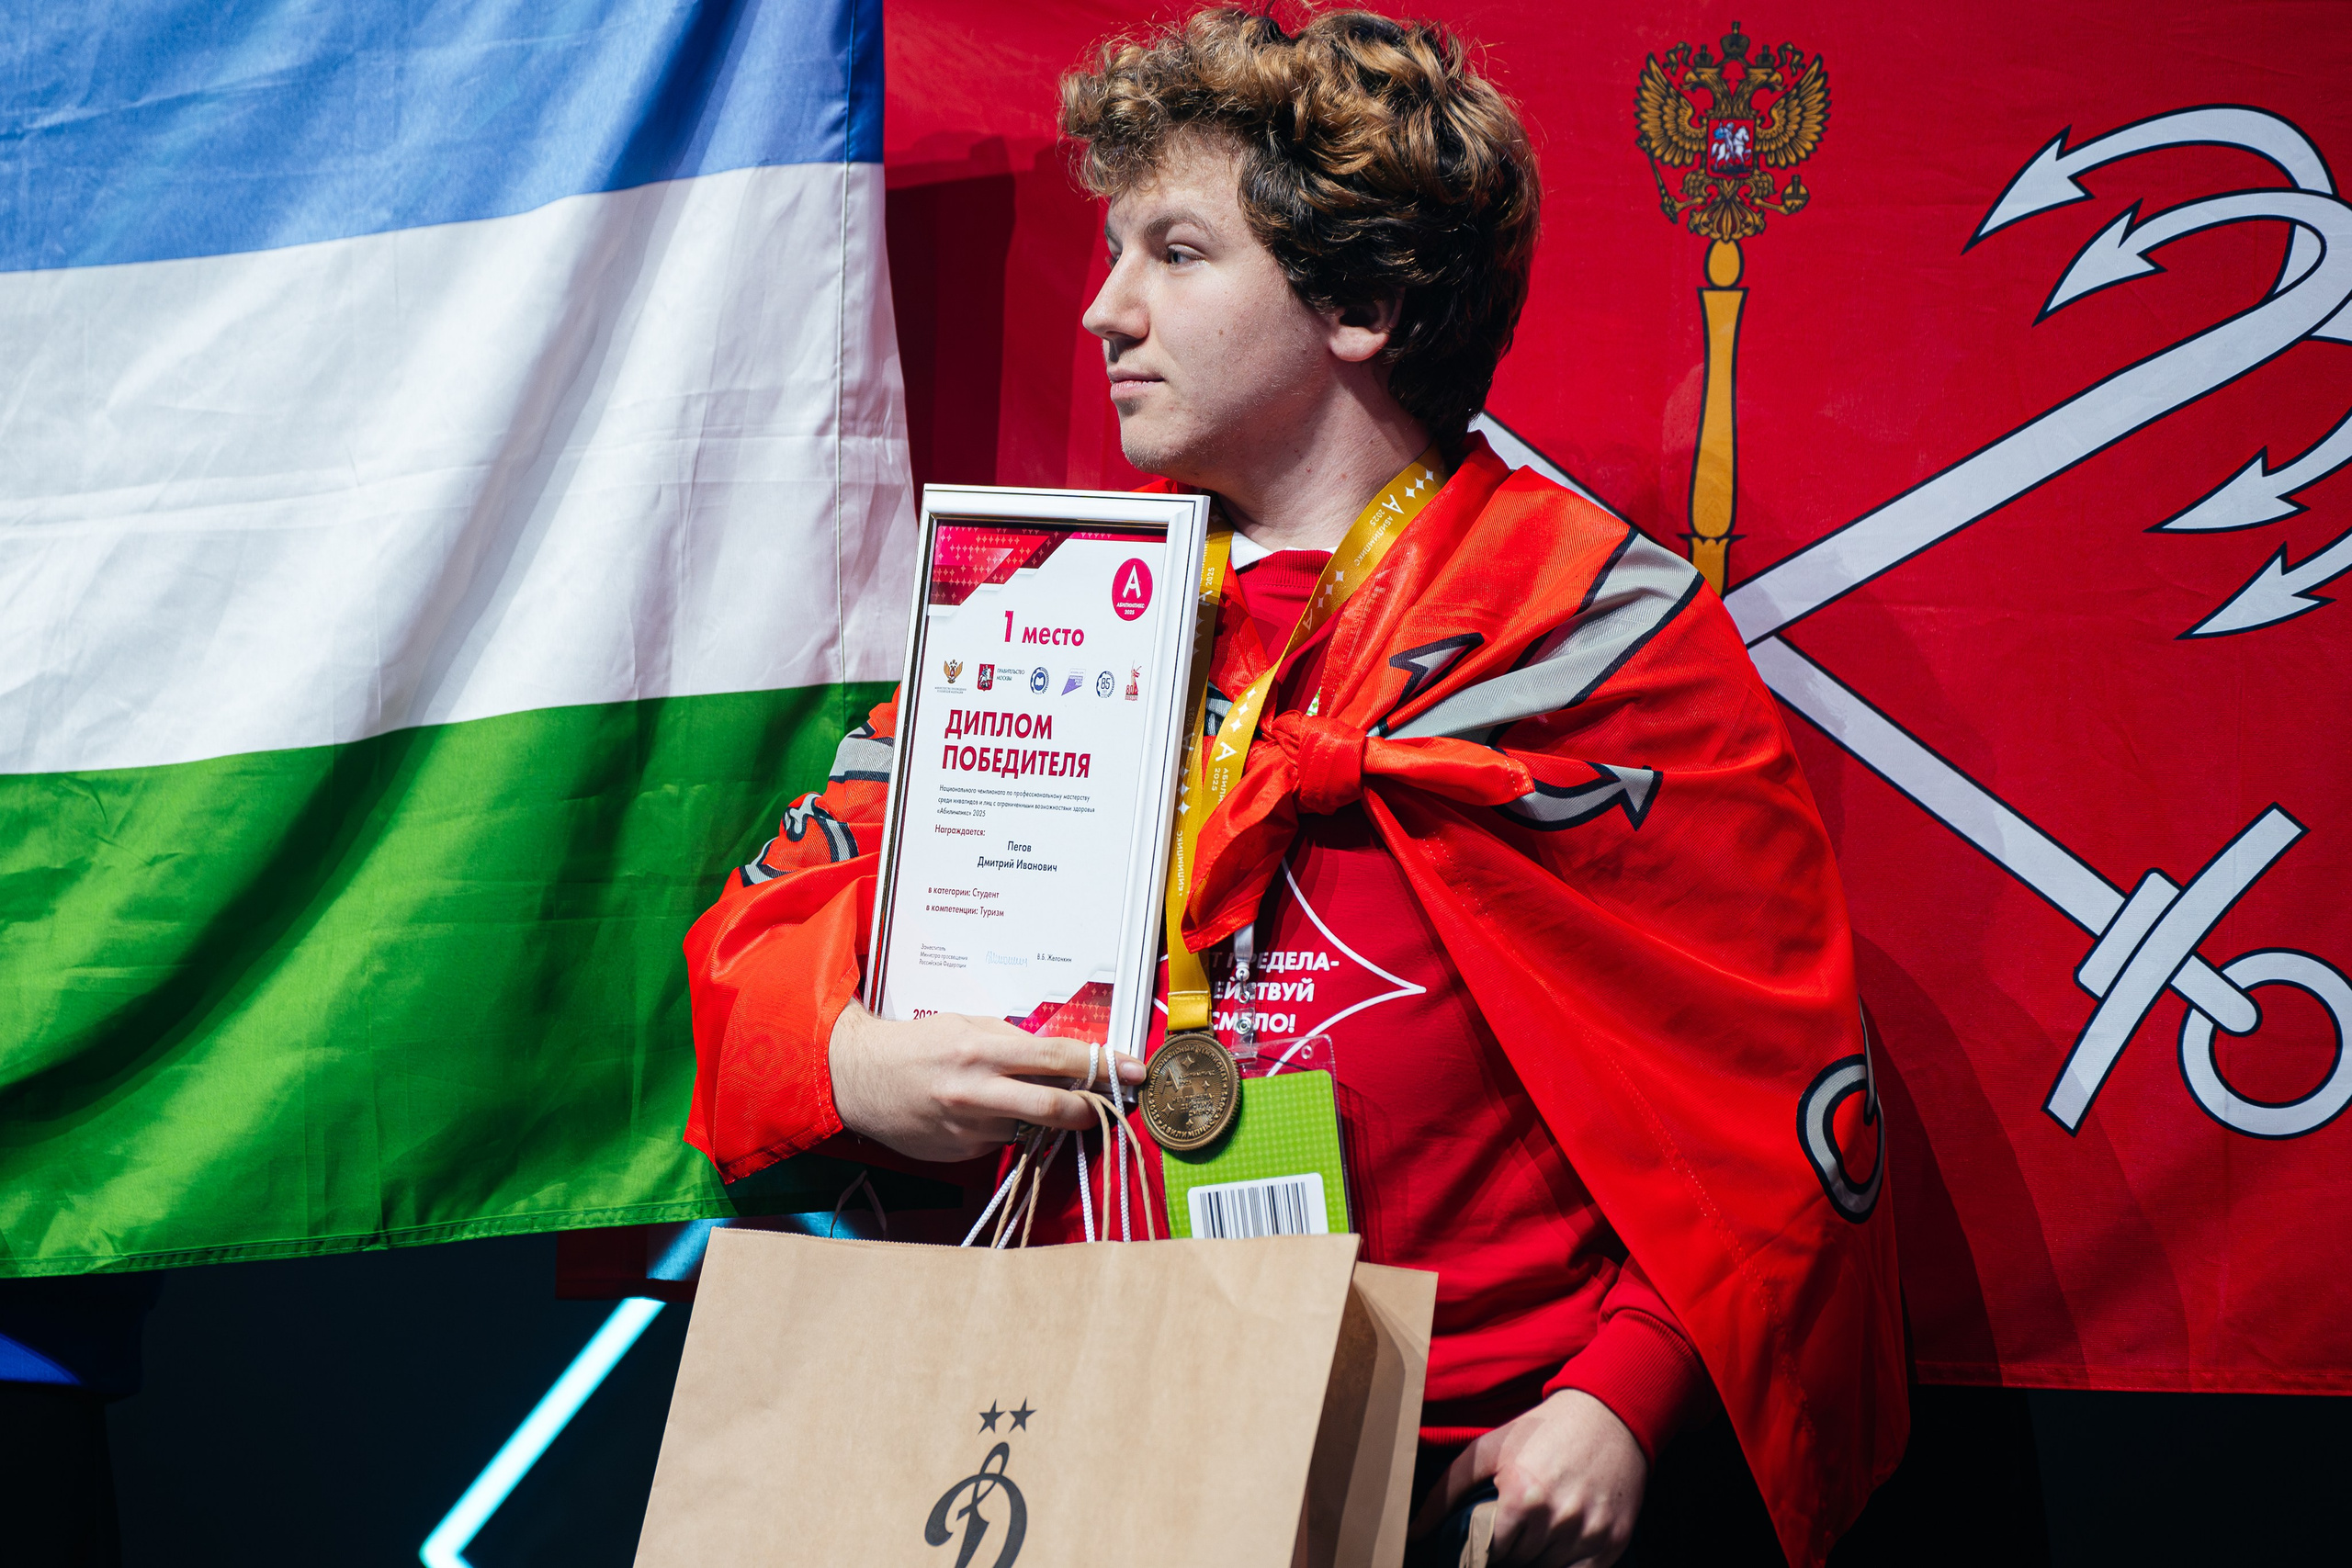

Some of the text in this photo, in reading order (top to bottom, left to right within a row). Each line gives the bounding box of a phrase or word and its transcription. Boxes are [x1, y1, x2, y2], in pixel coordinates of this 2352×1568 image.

[1369, 509, 1385, 527] 2025
[1353, 515, 1394, 567] АБИЛИМПИКС
[1205, 567, 1216, 586] 2025
[1004, 610, 1085, 647] 1 место
[1101, 677, 1111, 690] 85
[944, 709, 1053, 740] ДИПЛОМ
[942, 745, 1091, 779] ПОБЕДИТЕЛЯ
[1211, 767, 1221, 791] 2025
[939, 784, 977, 795] Национального
[978, 788, 1006, 796] чемпионата
[1013, 790, 1063, 801] профессиональному
[1063, 795, 1091, 803] мастерству
[972, 809, 986, 818] 2025
[997, 801, 1034, 809] ограниченными
[1035, 804, 1071, 812] возможностями
[934, 824, 986, 837] Награждается:
[1007, 840, 1032, 852] Пегов
[977, 856, 1057, 872] Дмитрий Иванович
[933, 886, 971, 898] категории:
[972, 888, 1000, 899] Студент
[931, 904, 978, 916] компетенции:
[979, 907, 1004, 918] Туризм
[921, 942, 946, 952] Заместитель
[919, 958, 943, 967] Российской
[920, 951, 942, 960] Министра
[1213, 977, 1315, 1002] ЕЙСТВУЙ
